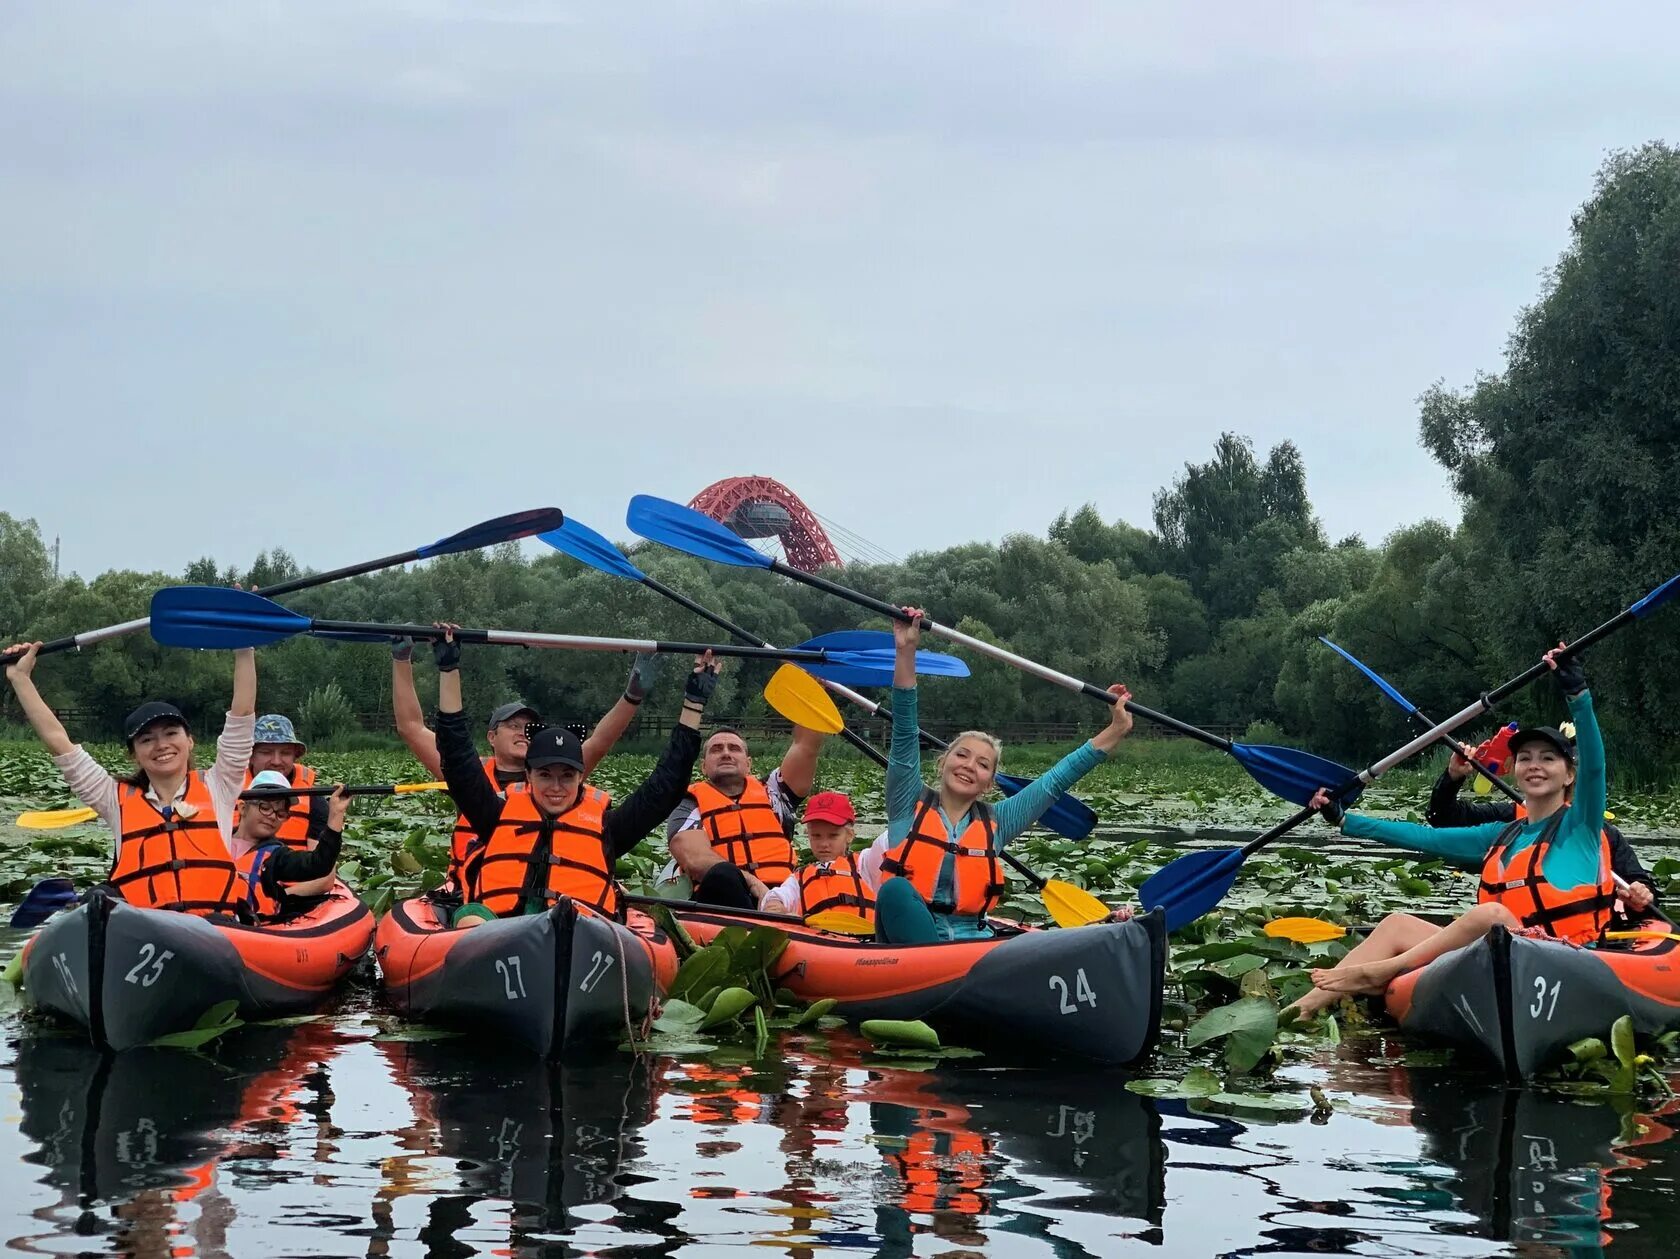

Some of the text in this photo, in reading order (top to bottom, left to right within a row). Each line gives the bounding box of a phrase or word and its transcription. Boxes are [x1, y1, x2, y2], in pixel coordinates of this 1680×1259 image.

[124, 943, 176, 987] 25
[495, 956, 526, 999] 27
[580, 951, 615, 993] 27
[1048, 968, 1097, 1015] 24
[1530, 976, 1561, 1021] 31
